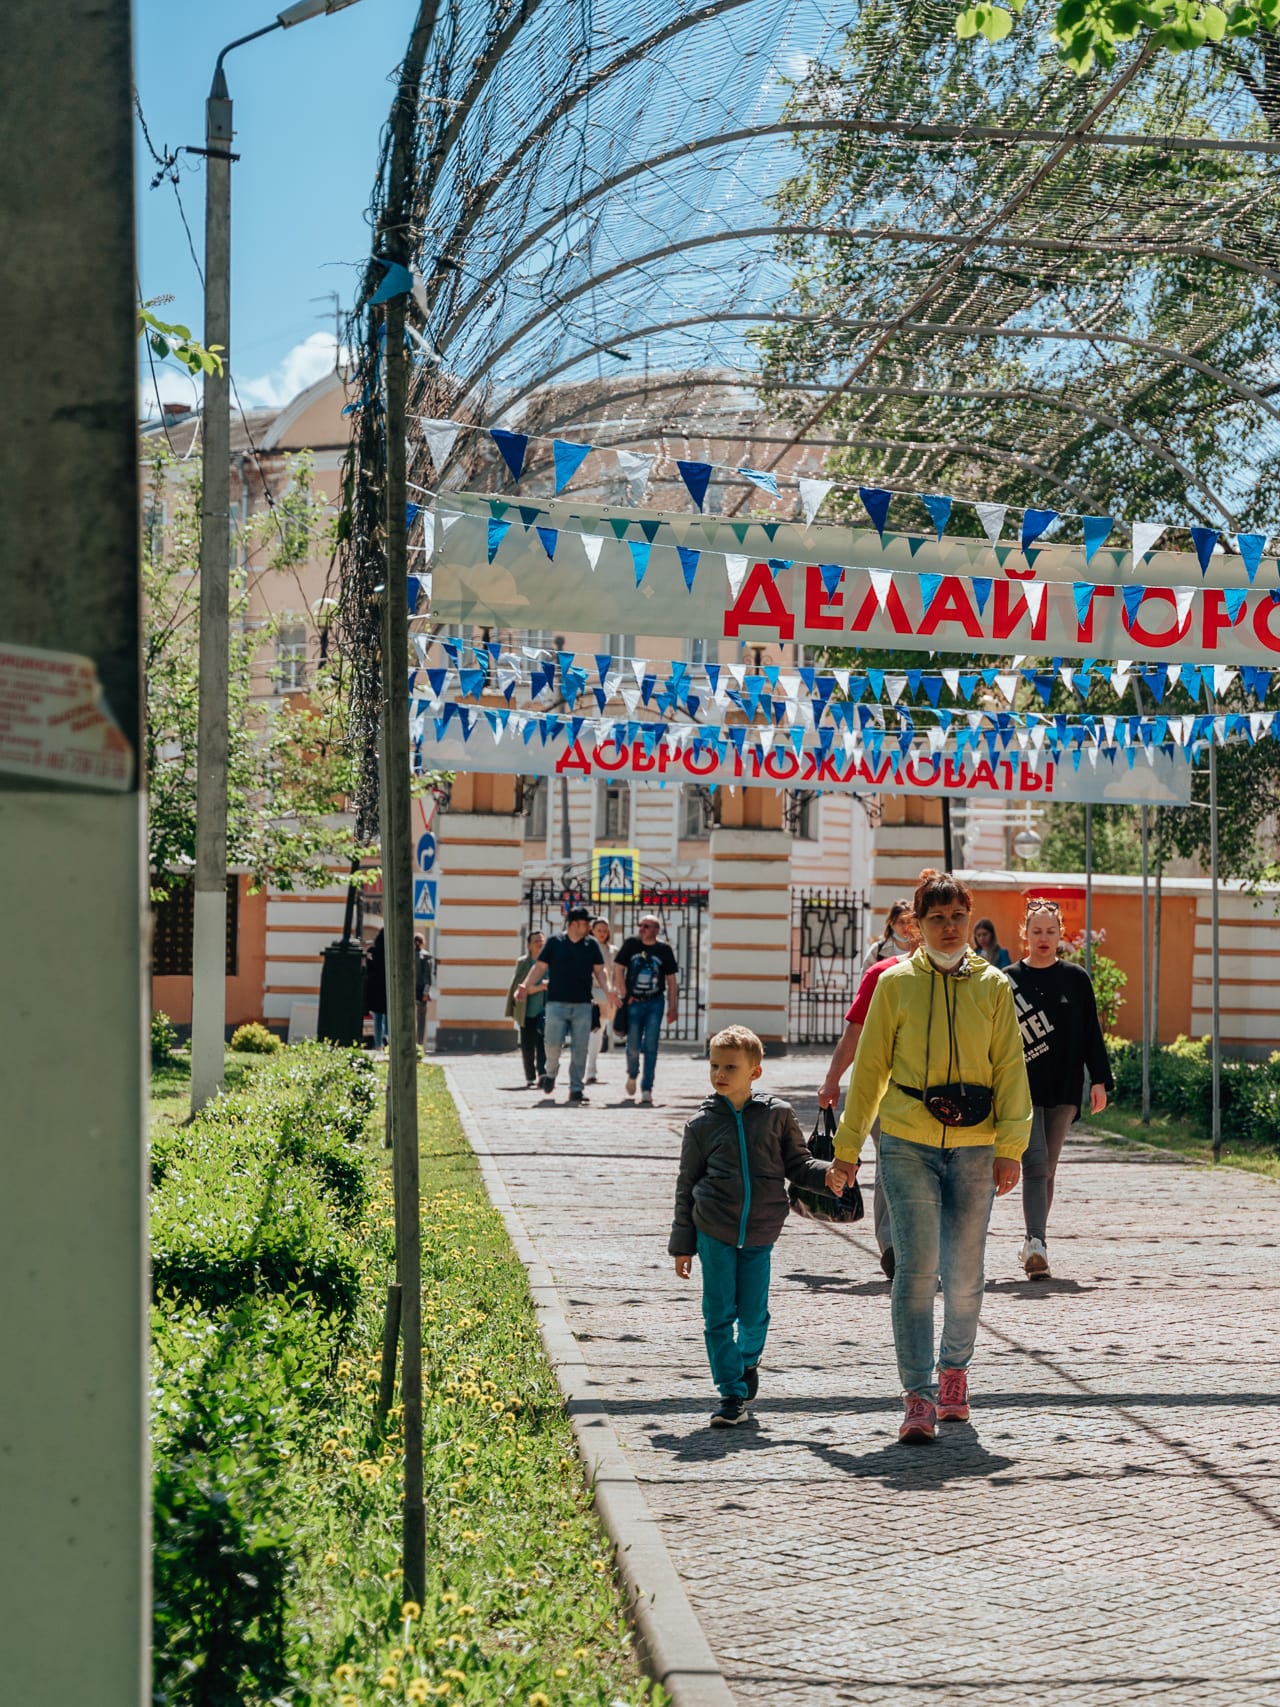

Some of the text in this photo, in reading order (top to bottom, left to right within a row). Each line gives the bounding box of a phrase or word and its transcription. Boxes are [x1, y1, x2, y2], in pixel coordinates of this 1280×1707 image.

[724, 563, 1048, 643] ДЕЛАЙ
[555, 738, 1054, 793] ДОБРО ПОЖАЛОВАТЬ!
